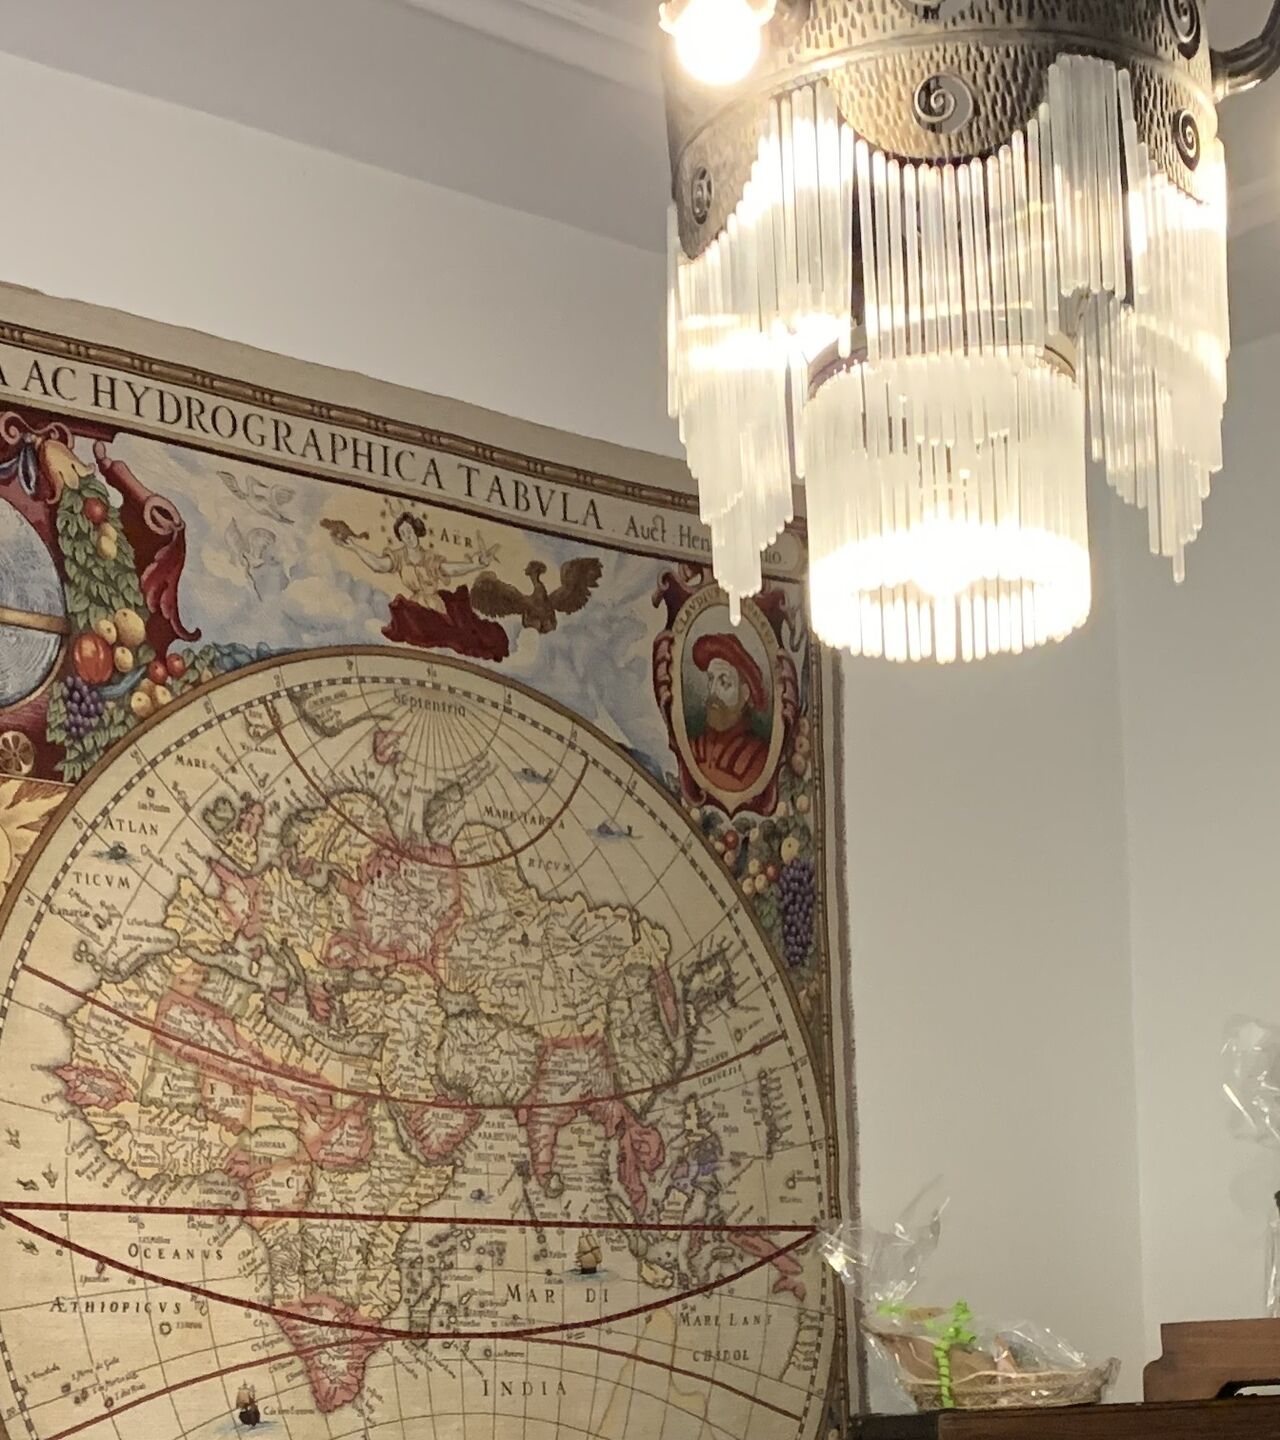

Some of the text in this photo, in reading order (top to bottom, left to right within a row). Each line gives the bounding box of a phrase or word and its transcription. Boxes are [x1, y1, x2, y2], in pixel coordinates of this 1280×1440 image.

[21, 359, 78, 401] AC
[90, 373, 444, 491] HYDROGRAPHICA
[394, 690, 466, 718] Septentrio
[103, 817, 159, 836] ATLAN
[73, 870, 131, 890] TICVM
[128, 1243, 224, 1260] OCEANVS
[505, 1283, 556, 1304] MAR
[482, 1379, 568, 1397] INDIA
